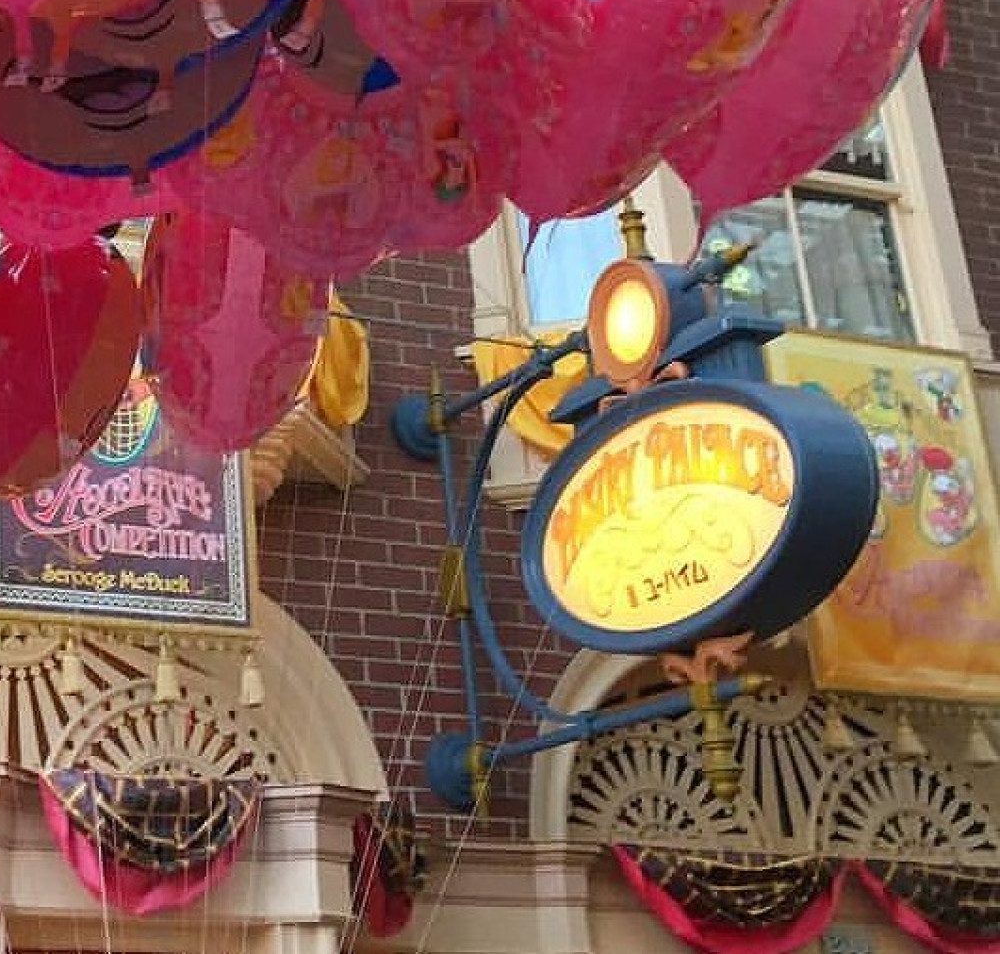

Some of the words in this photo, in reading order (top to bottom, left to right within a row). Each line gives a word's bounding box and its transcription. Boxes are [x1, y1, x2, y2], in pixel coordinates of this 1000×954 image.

[78, 521, 227, 561] COMPETITION
[40, 564, 117, 591] Scrooge
[119, 567, 190, 593] McDuck
